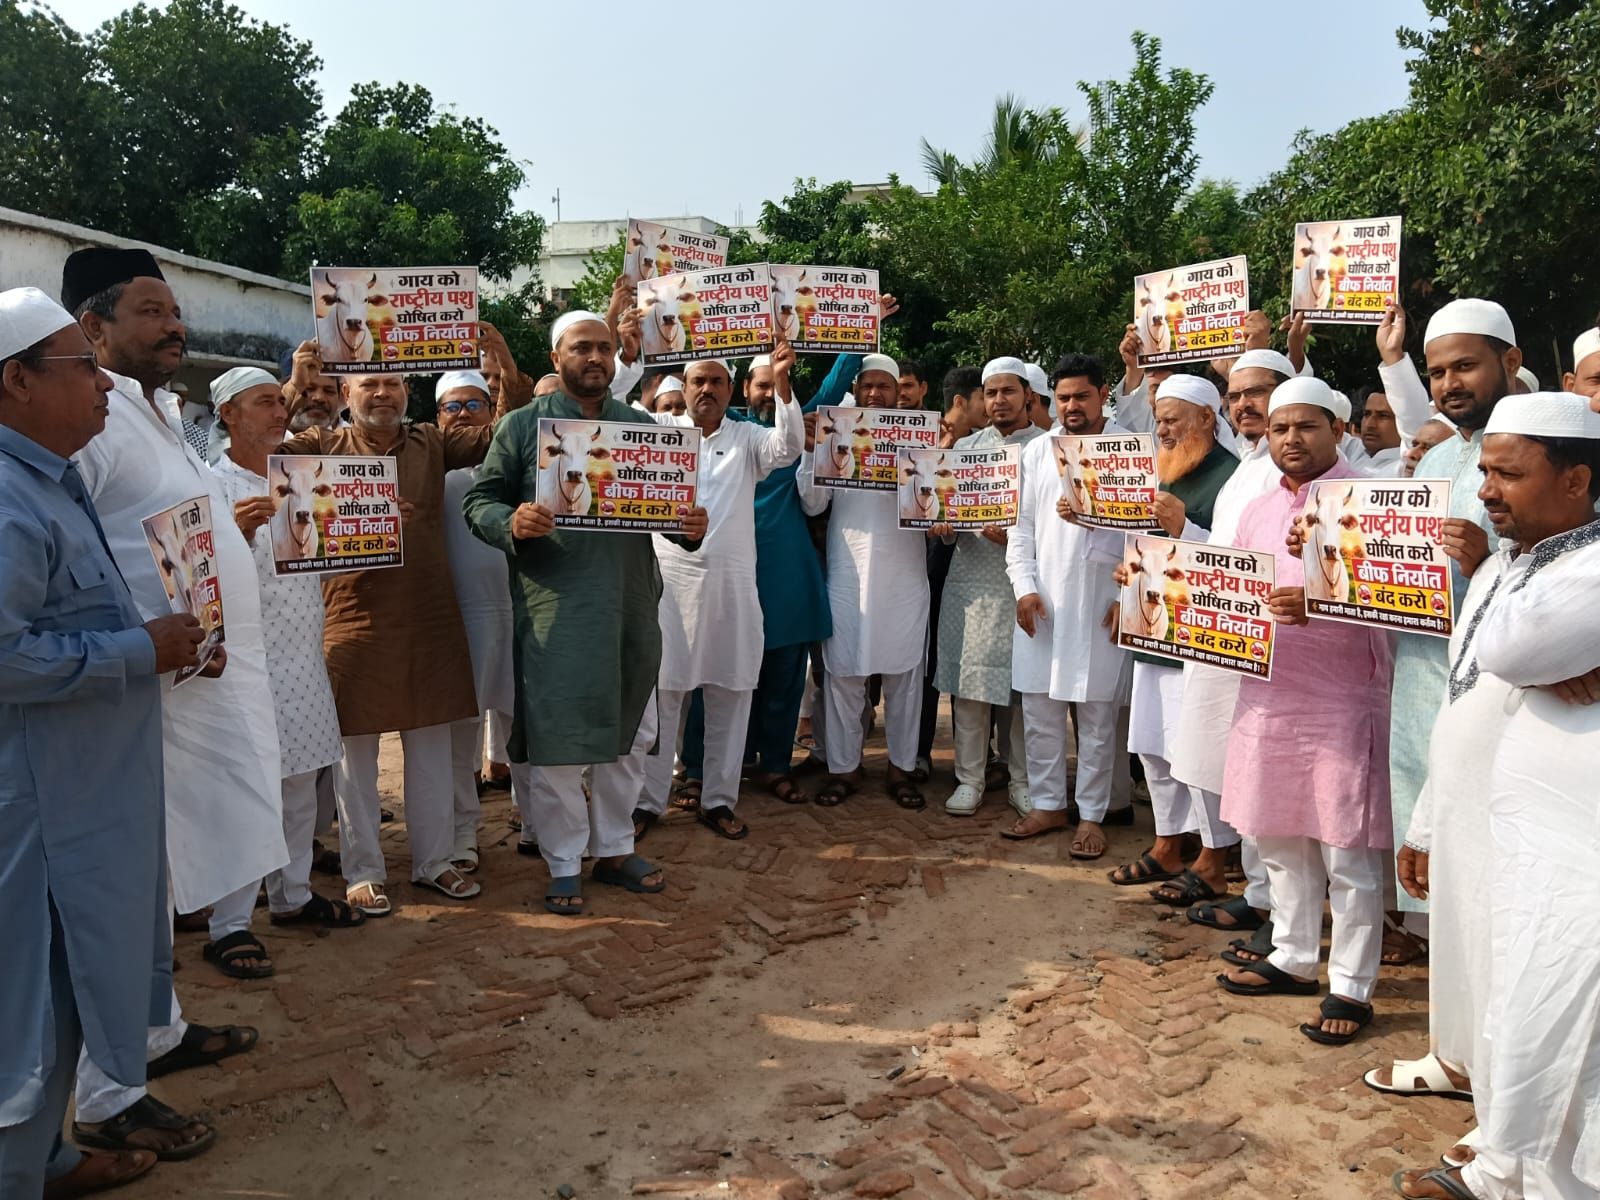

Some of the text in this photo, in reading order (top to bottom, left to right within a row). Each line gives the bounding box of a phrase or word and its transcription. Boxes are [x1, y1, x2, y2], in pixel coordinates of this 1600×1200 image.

[398, 271, 460, 287] गाय को
[704, 268, 754, 284] गाय को
[822, 272, 866, 284] गाय को
[1188, 263, 1233, 282] गाय को
[696, 285, 768, 303] राष्ट्रीय पशु
[814, 284, 876, 304] राष्ट्रीय पशु
[1224, 280, 1245, 298] पशु
[389, 288, 474, 309] राष्ट्रीय पशु
[703, 301, 760, 316] घोषित करो
[818, 301, 869, 313] घोषित करो
[1186, 298, 1236, 316] घोषित करो
[397, 308, 464, 323] घोषित करो
[809, 314, 873, 328] बीफ निर्यात
[694, 315, 766, 333] बीफ निर्यात
[1178, 319, 1202, 333] बीफ
[385, 324, 470, 343] बीफ निर्यात
[710, 330, 753, 345] बंद करो
[821, 329, 860, 340] बंद करो
[1191, 331, 1229, 346] बंद करो
[404, 342, 455, 356] बंद करो
[880, 414, 926, 426] गाय को
[622, 430, 684, 446] गाय को
[871, 426, 936, 446] राष्ट्रीय पशु
[875, 442, 905, 452] घोषि
[1096, 437, 1140, 453] गाय को
[611, 445, 696, 472] राष्ट्रीय पशु
[865, 455, 890, 467] बीफ
[960, 450, 1007, 464] गाय को
[1133, 456, 1154, 474] पशु
[339, 461, 384, 477] गाय को
[618, 466, 685, 483] घोषित करो
[876, 469, 893, 479] बंद
[952, 464, 1017, 481] राष्ट्रीय पशु
[958, 479, 1009, 492] घोषित करो
[1099, 473, 1146, 486] घोषित करो
[332, 479, 396, 502] राष्ट्रीय पशु
[604, 483, 689, 501] बीफ निर्यात
[1095, 488, 1115, 502] बीफ
[1370, 485, 1432, 508] गाय को
[949, 492, 1012, 506] बीफ निर्यात
[338, 501, 390, 516] घोषित करो
[620, 501, 672, 516] बंद करो
[962, 506, 1002, 518] बंद करो
[1107, 505, 1142, 516] बंद करो
[328, 519, 394, 536] बीफ निर्यात
[1359, 509, 1411, 538] राष्ट्रीय
[343, 536, 383, 552] बंद करो
[1366, 539, 1434, 561] घोषित करो
[1196, 551, 1258, 574] गाय को
[1357, 563, 1442, 589] बीफ निर्यात
[1186, 569, 1272, 604] राष्ट्रीय पशु
[1192, 591, 1260, 617] घोषित करो
[1375, 587, 1427, 609] बंद करो
[1180, 610, 1266, 640] बीफ निर्यात
[1195, 631, 1247, 654] बंद करो
